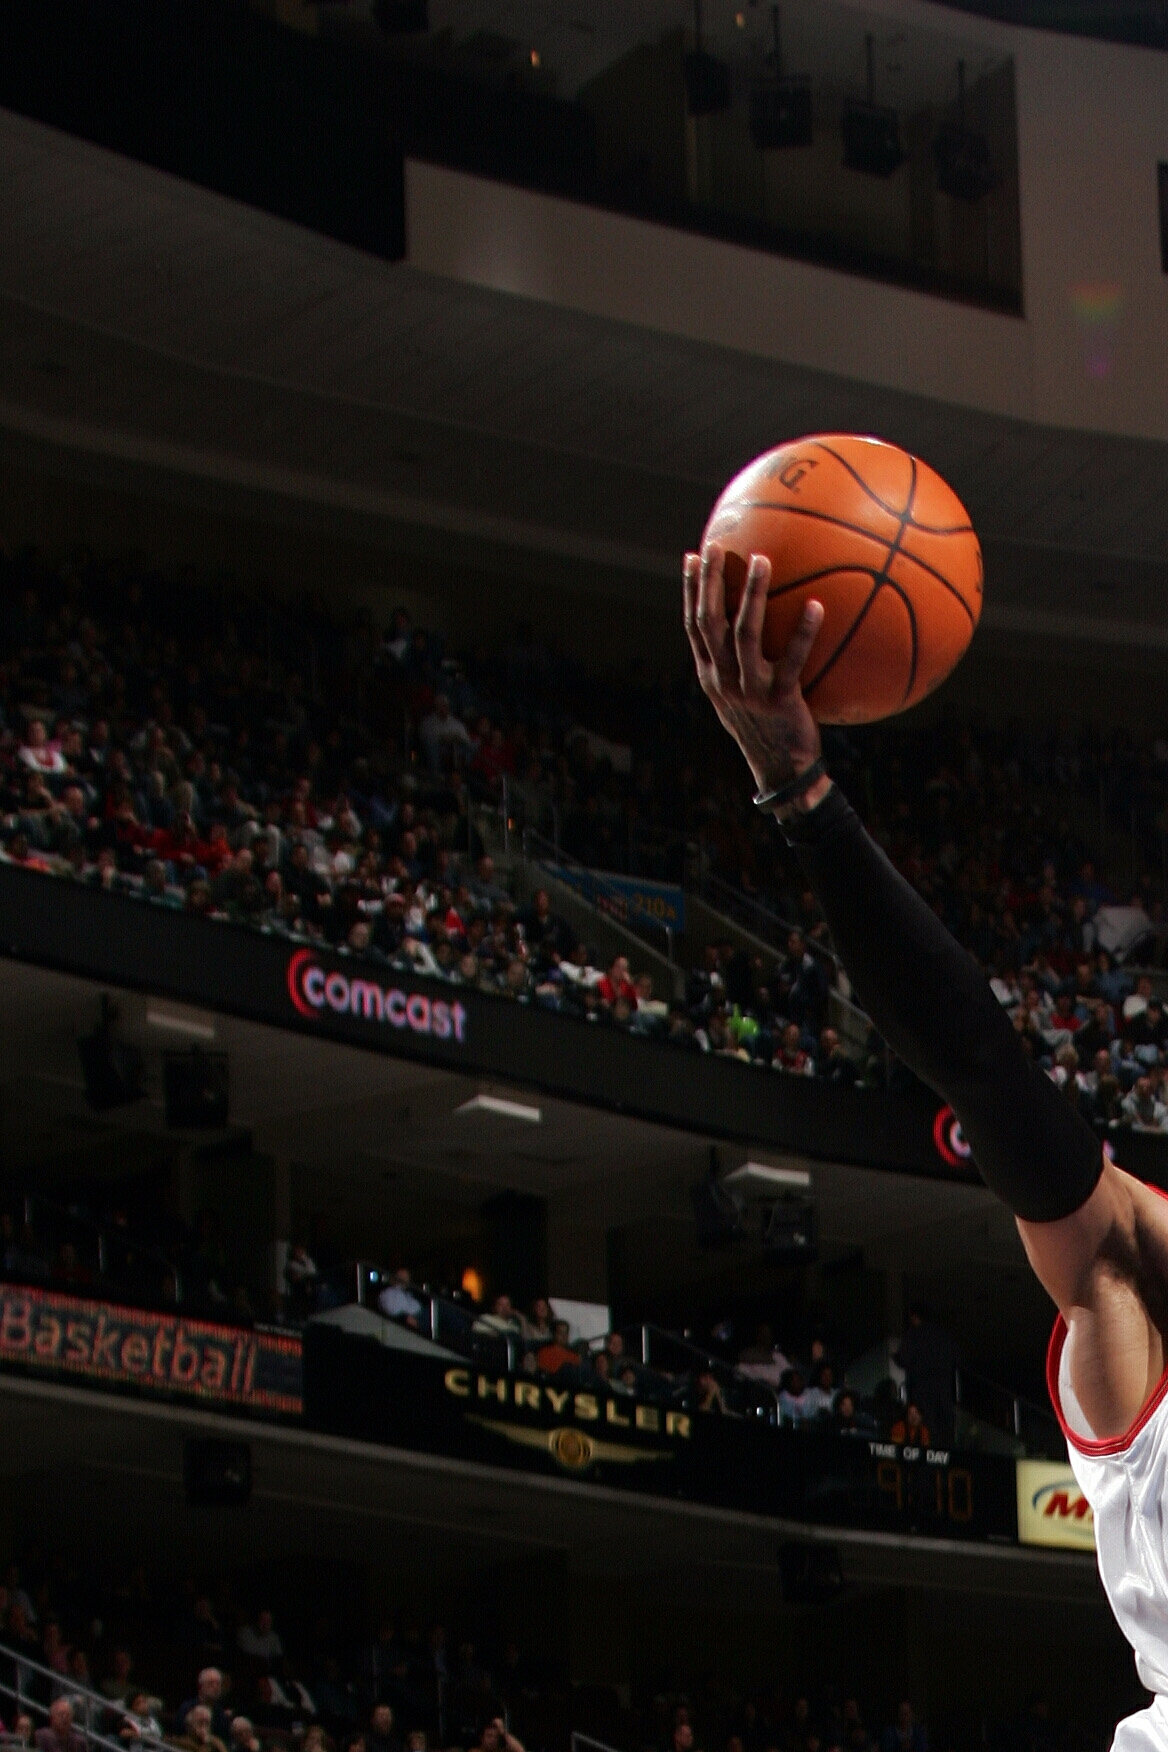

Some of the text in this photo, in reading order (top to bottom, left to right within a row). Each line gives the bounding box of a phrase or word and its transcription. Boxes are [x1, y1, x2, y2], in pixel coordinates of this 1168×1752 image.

[301, 964, 465, 1044] comcast
[1, 1300, 258, 1393] Basketball
[444, 1368, 692, 1438] CHRYSLER
[868, 1441, 950, 1465] TIME OF DAY
